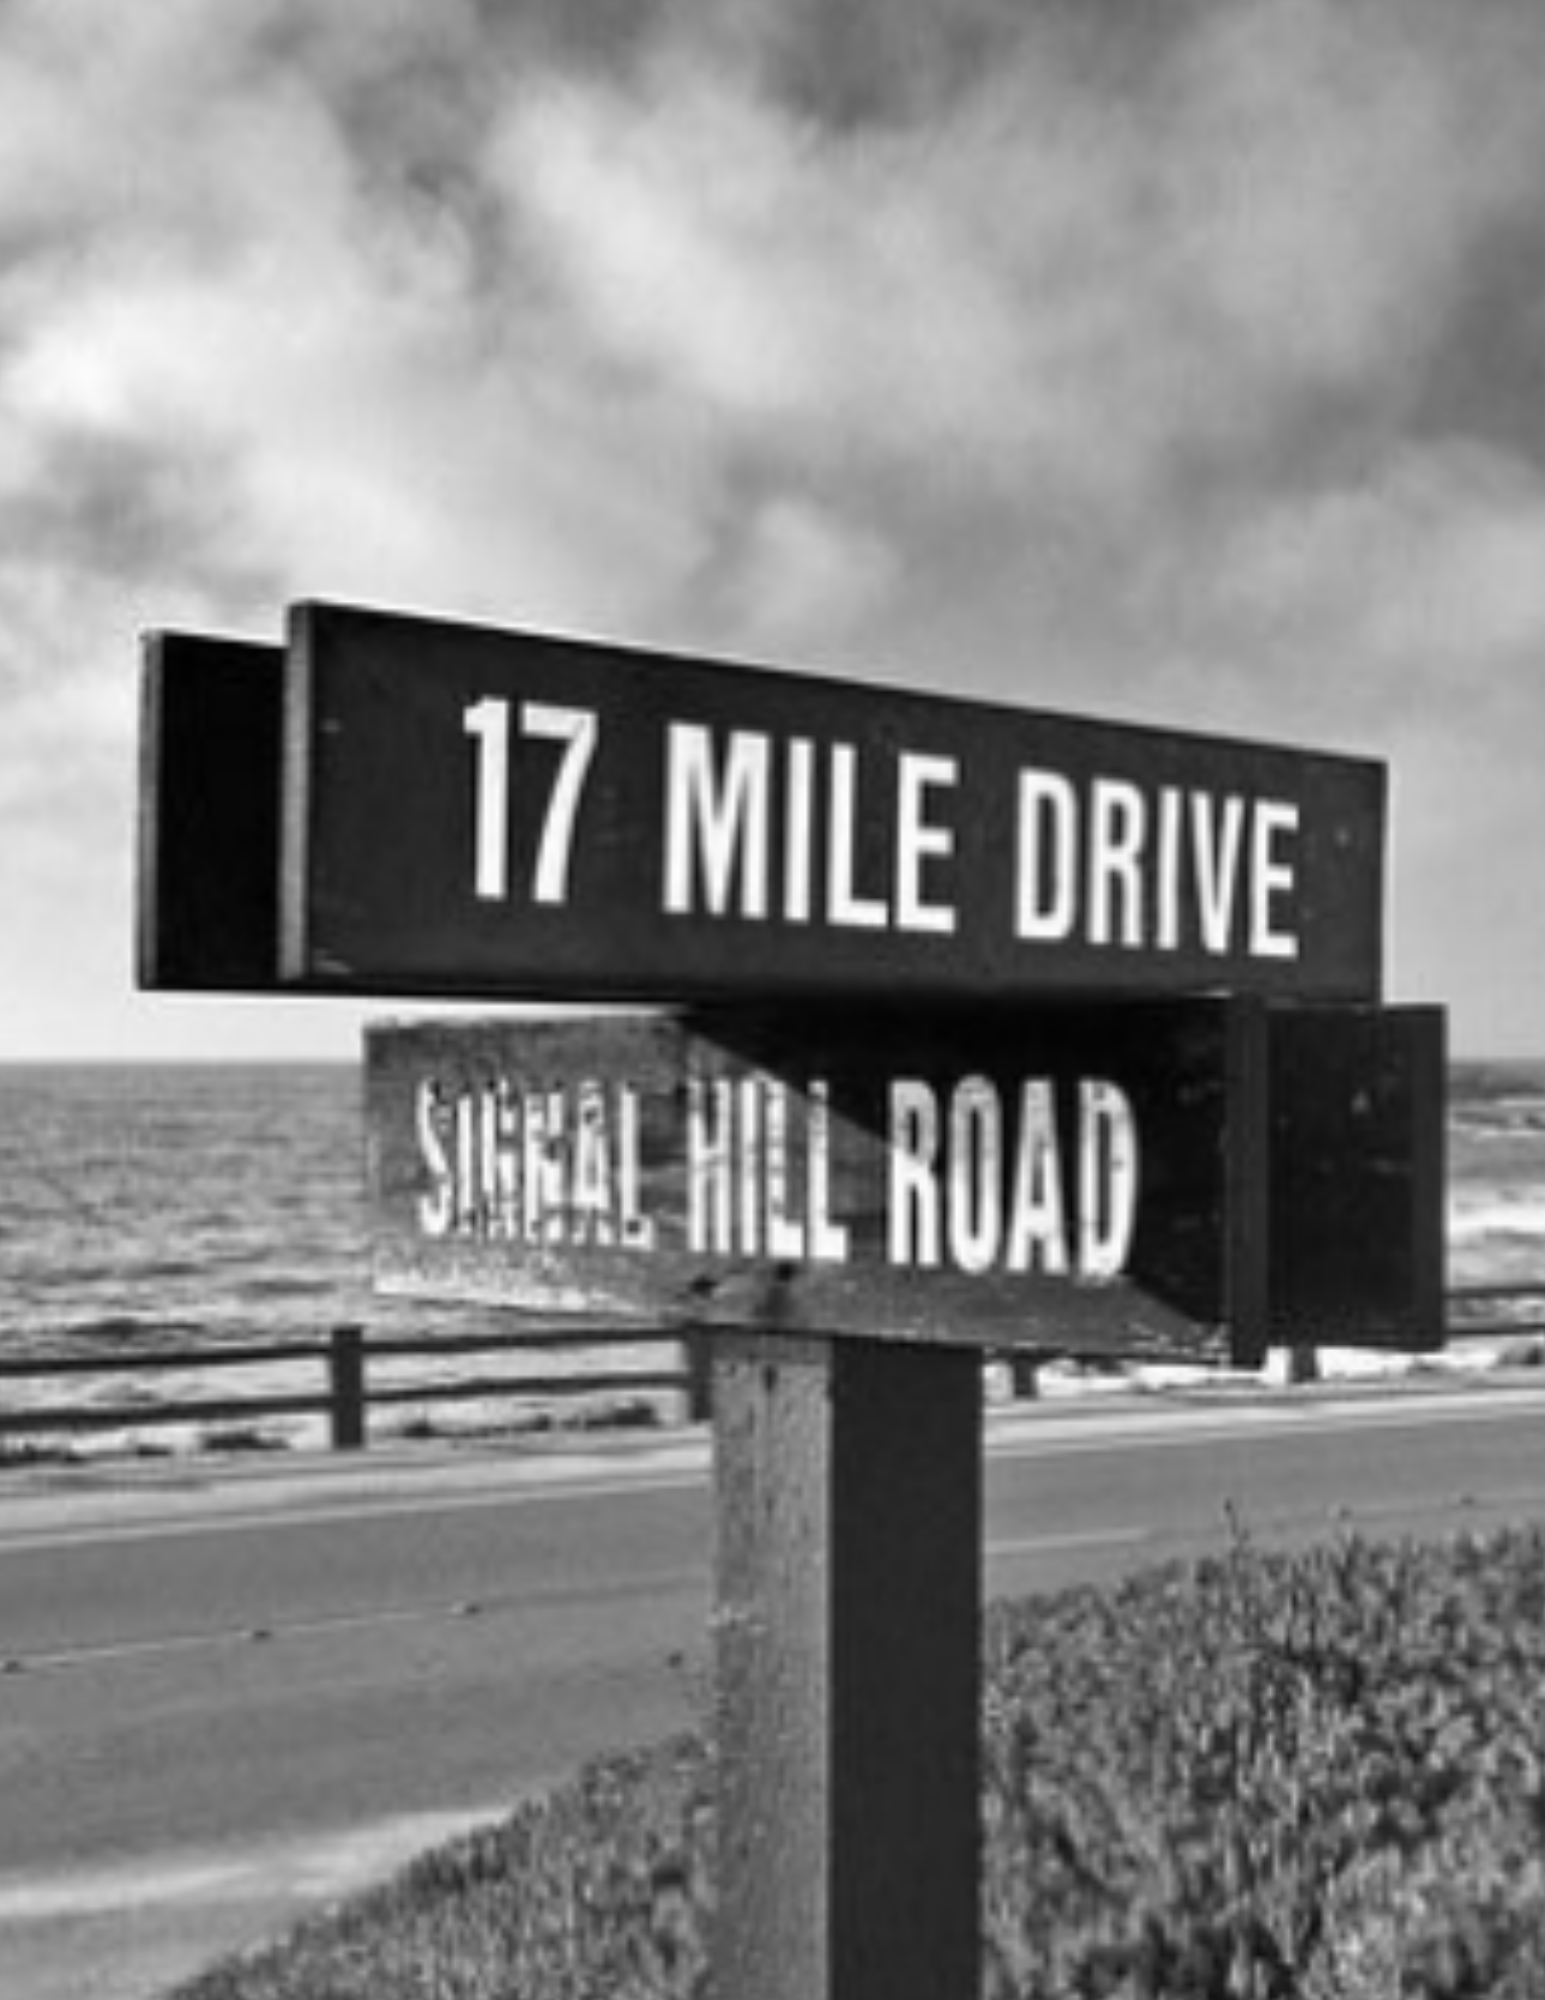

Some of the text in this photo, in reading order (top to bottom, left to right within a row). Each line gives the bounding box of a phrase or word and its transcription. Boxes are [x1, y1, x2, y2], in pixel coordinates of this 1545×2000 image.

[463, 697, 1300, 959] 17 MILE DRIVE
[416, 1074, 1137, 1279] SIGNAL HILL ROAD
